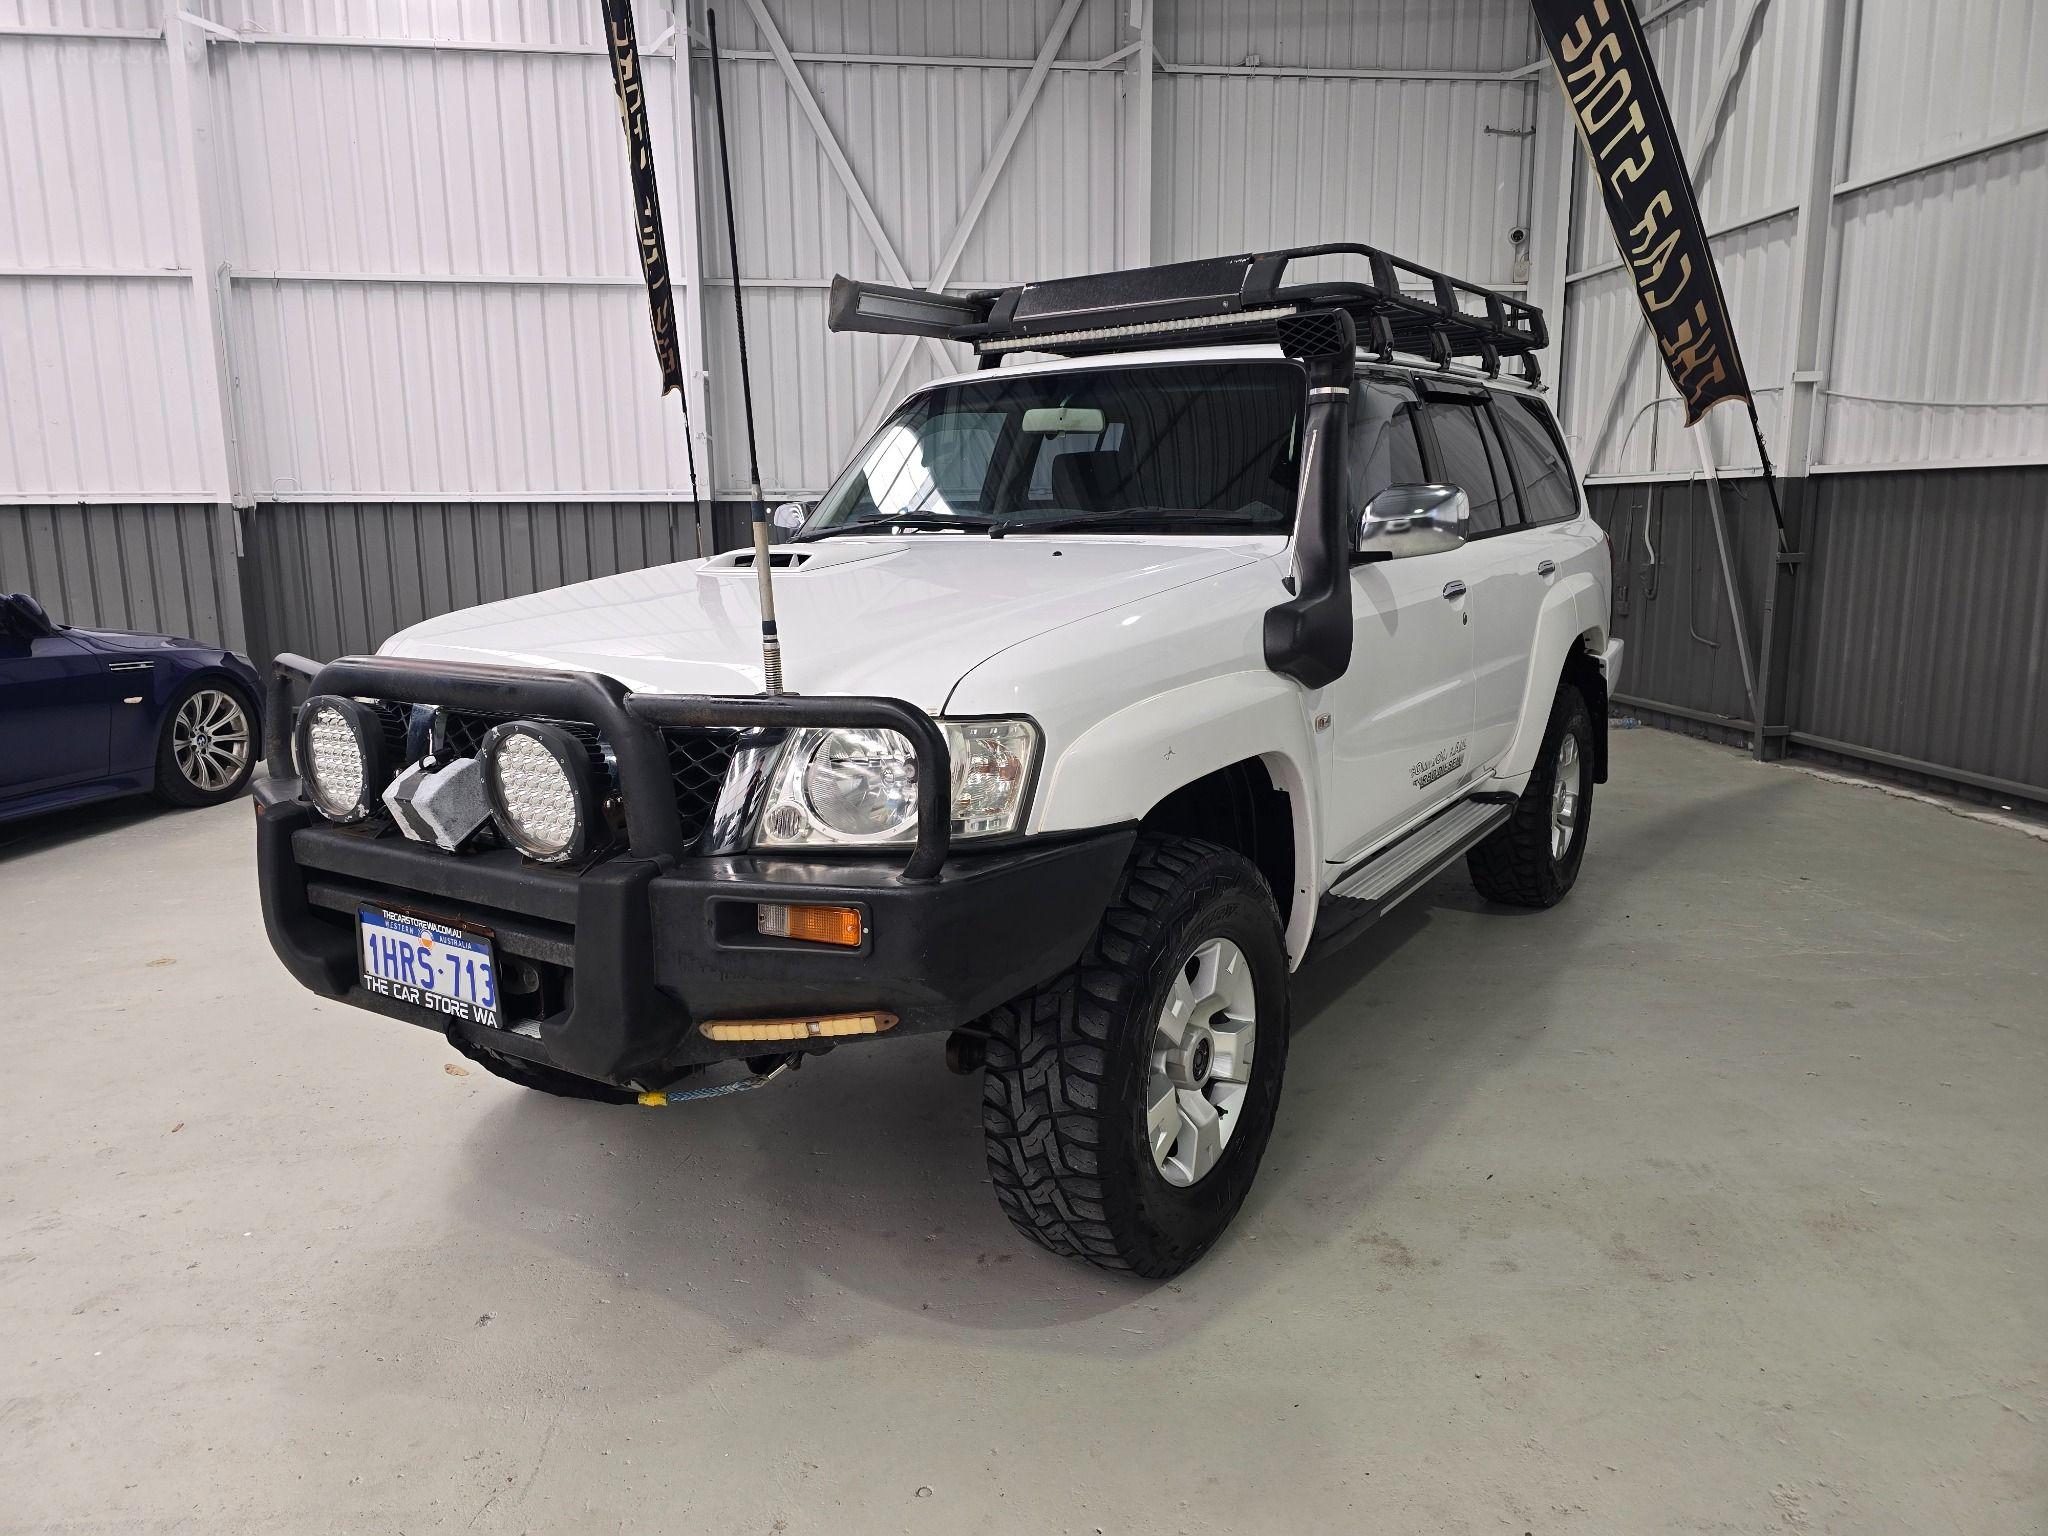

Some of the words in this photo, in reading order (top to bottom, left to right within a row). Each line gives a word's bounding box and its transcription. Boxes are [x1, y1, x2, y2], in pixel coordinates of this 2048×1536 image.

[384, 920, 414, 935] WESTERN
[439, 935, 472, 950] AUSTRALIA
[364, 974, 388, 996] THE
[394, 983, 420, 1005] CAR
[425, 992, 469, 1019] STORE
[473, 1006, 498, 1028] WA
